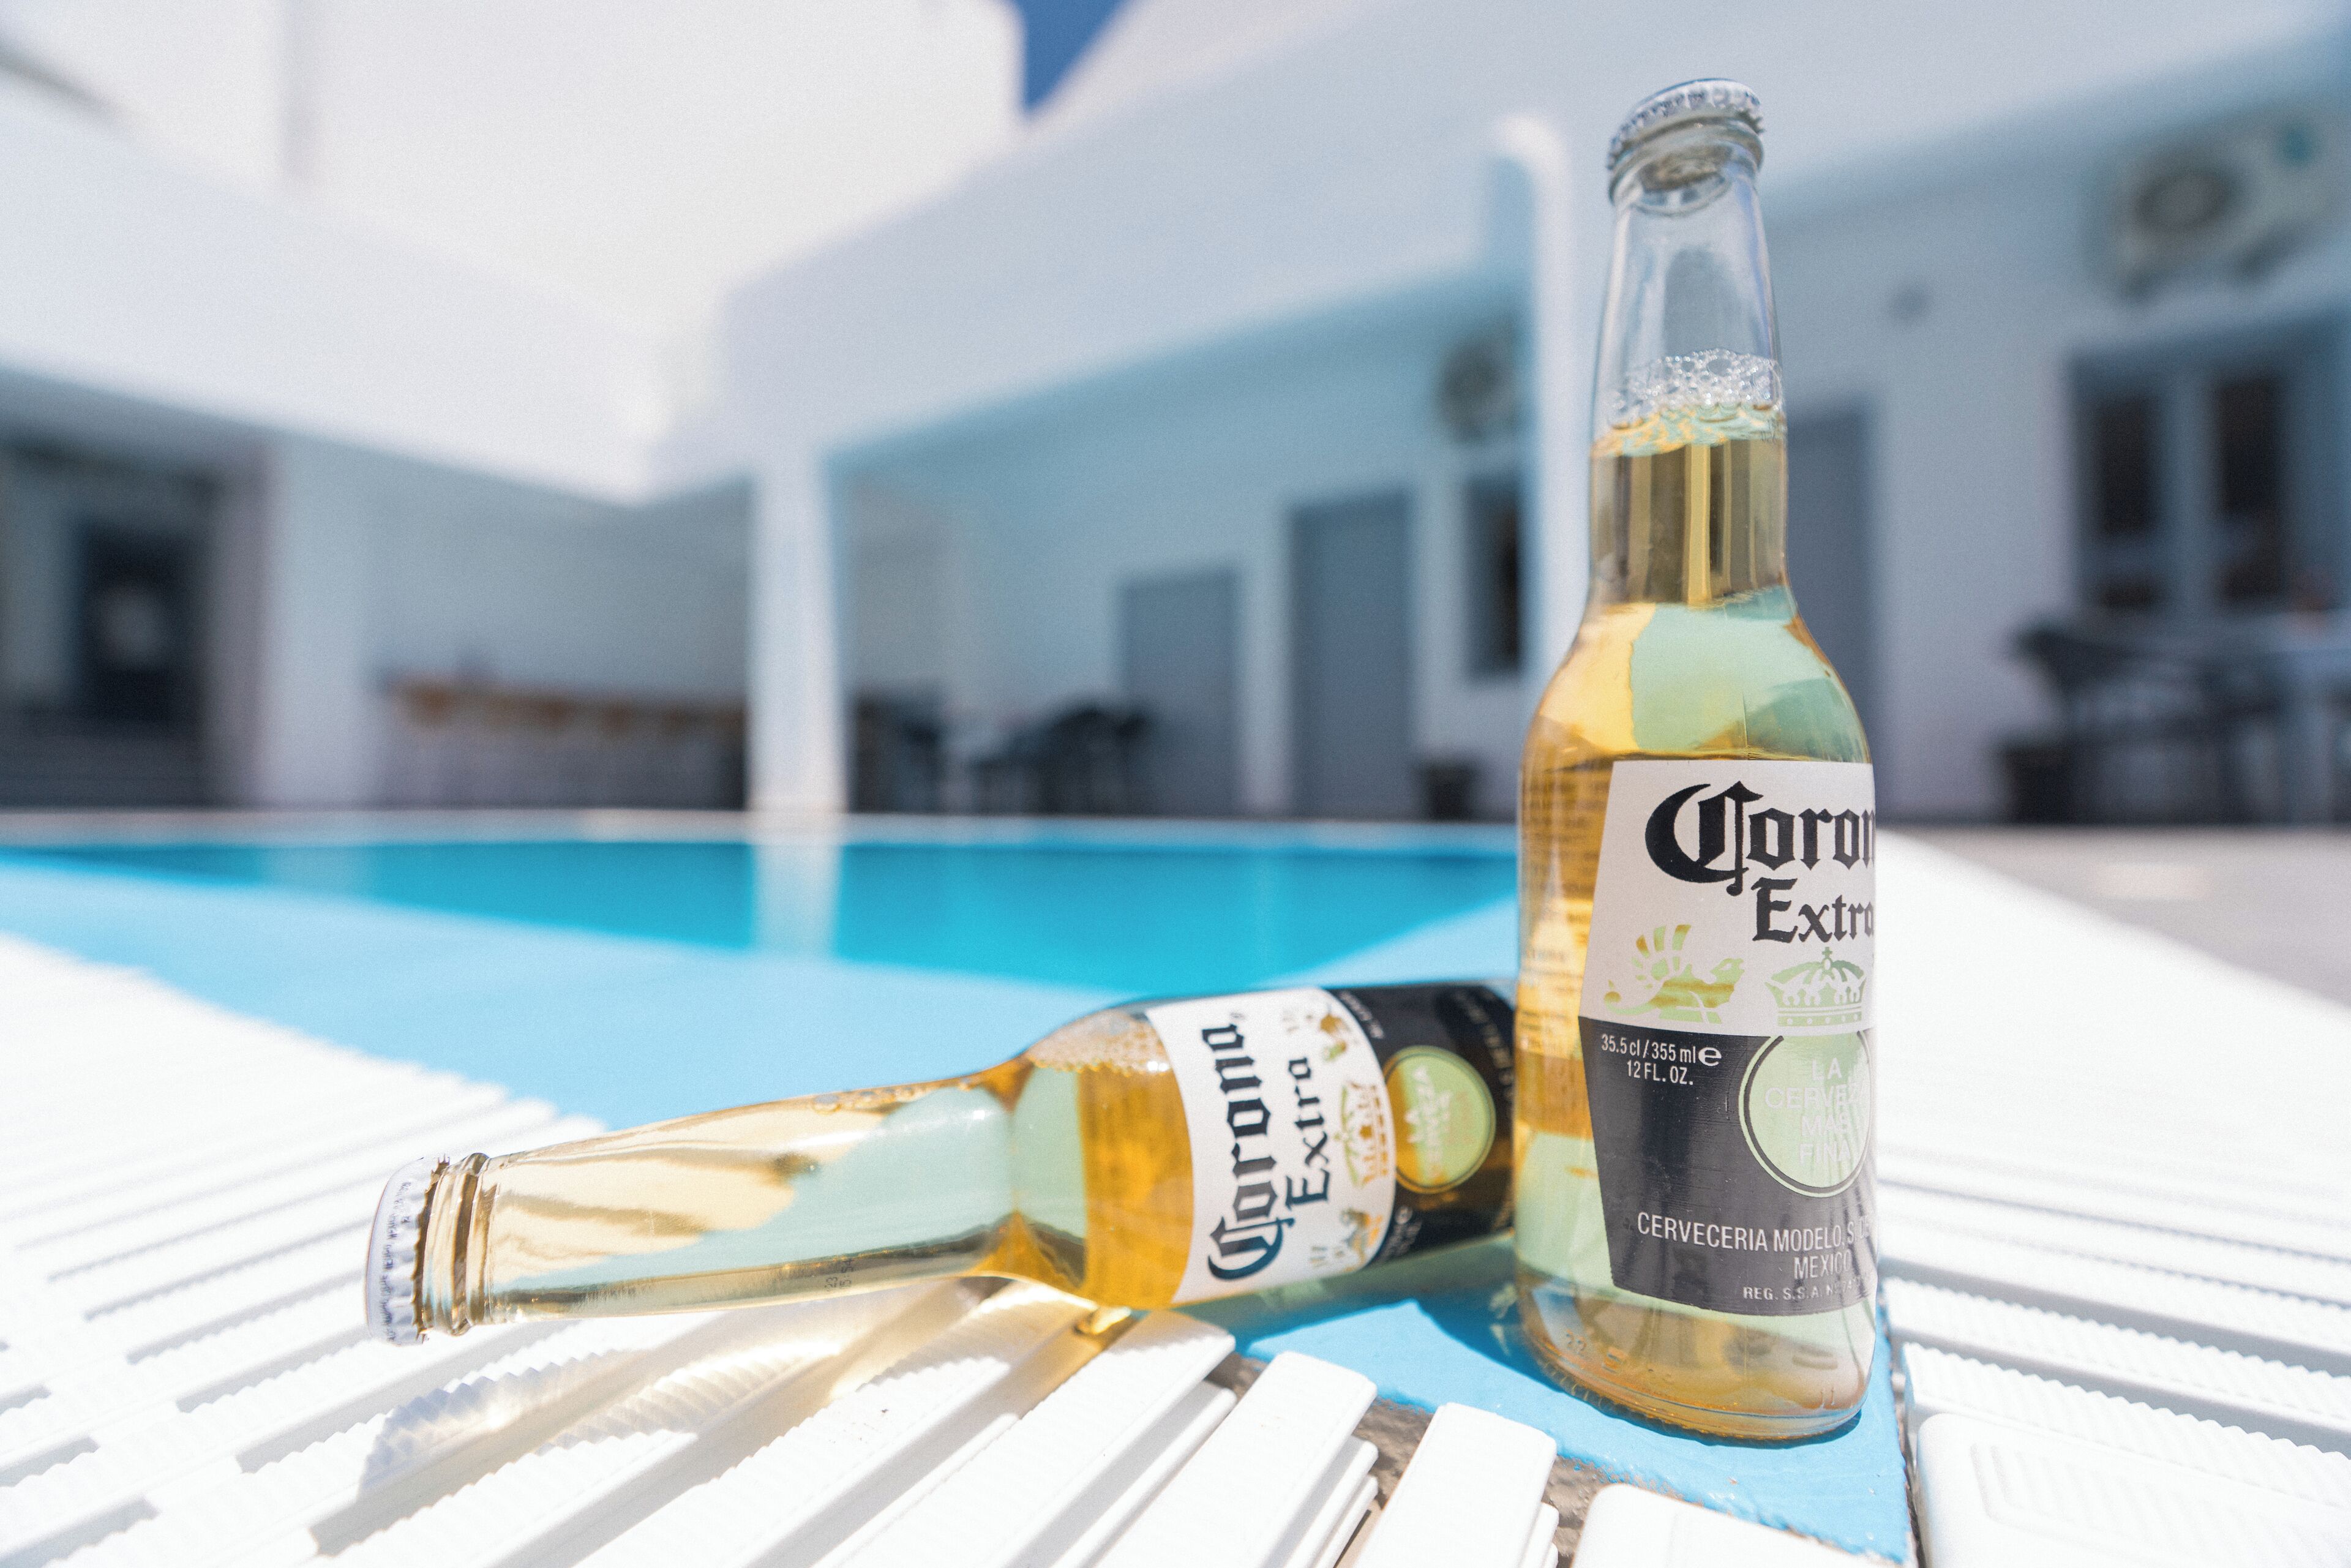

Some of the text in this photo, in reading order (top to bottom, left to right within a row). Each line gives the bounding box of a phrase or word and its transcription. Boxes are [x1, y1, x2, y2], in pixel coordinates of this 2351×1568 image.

[1645, 780, 1875, 896] Coron
[1751, 877, 1875, 943] Extra
[1627, 1059, 1693, 1086] 12 FL. OZ.
[1812, 1057, 1842, 1081] LA
[1286, 1056, 1332, 1209] Extra
[1801, 1111, 1850, 1137] MAS
[1201, 1022, 1295, 1280] Corona
[1799, 1139, 1851, 1165] FINA
[1637, 1211, 1768, 1252] CERVECERIA
[1793, 1249, 1852, 1280] MEXICO
[1742, 1286, 1779, 1301] REG.
